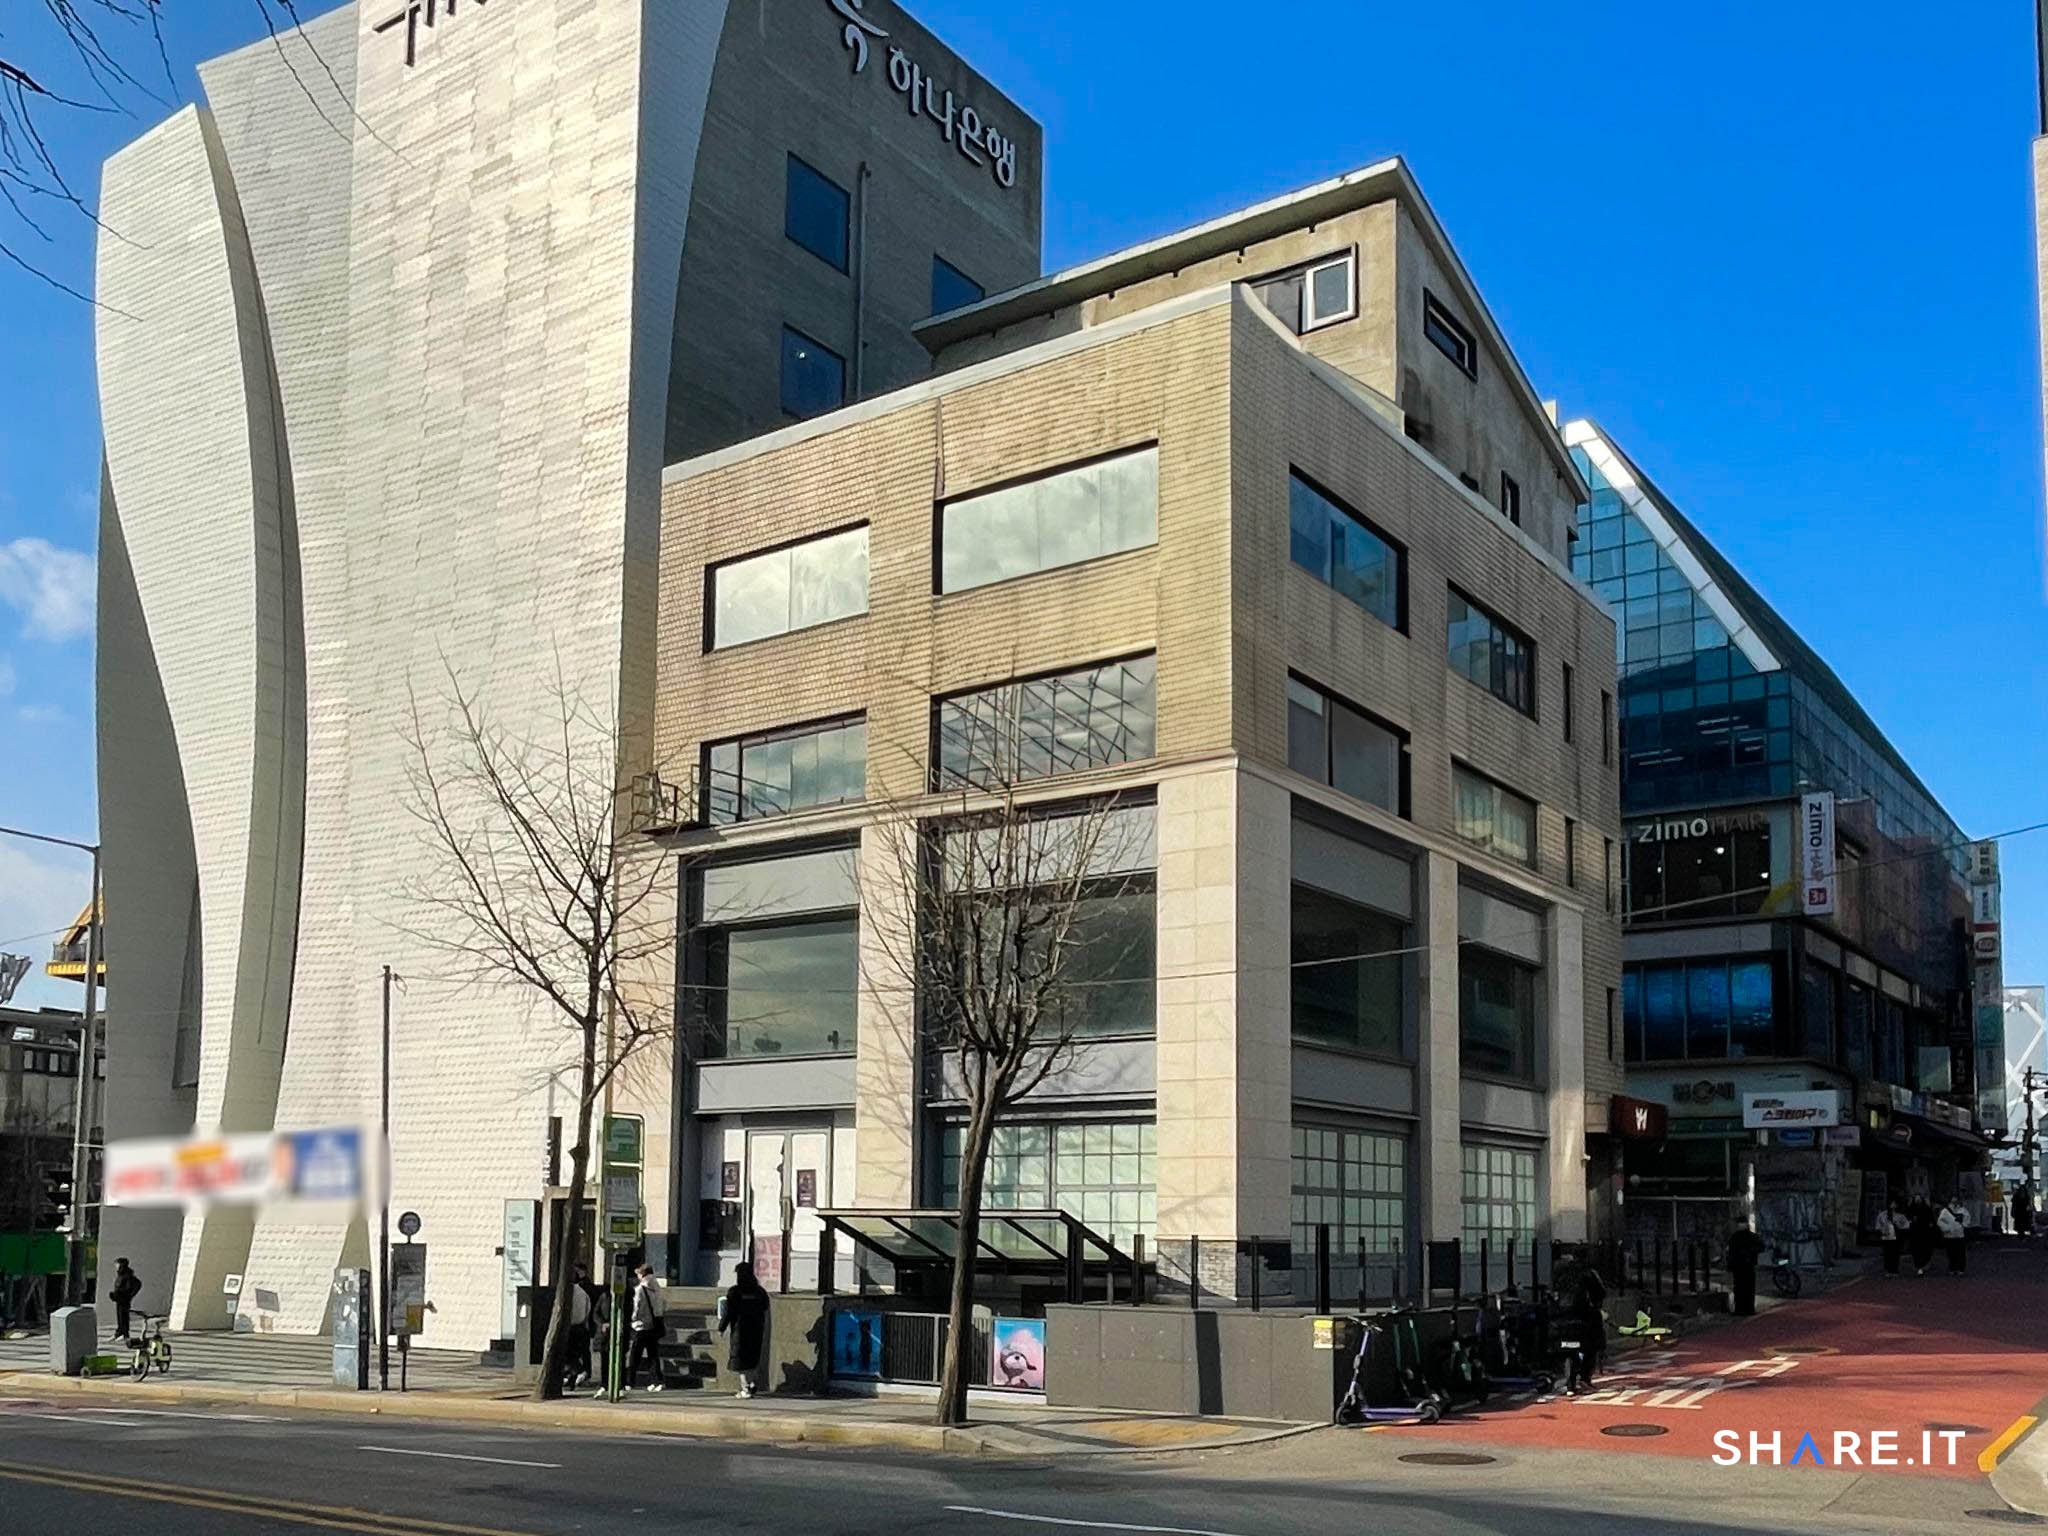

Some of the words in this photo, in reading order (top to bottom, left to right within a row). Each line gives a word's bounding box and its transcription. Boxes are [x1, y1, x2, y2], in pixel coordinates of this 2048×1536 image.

[889, 46, 1016, 188] 하나은행
[1638, 816, 1708, 843] zimo
[1809, 802, 1825, 847] zimo
